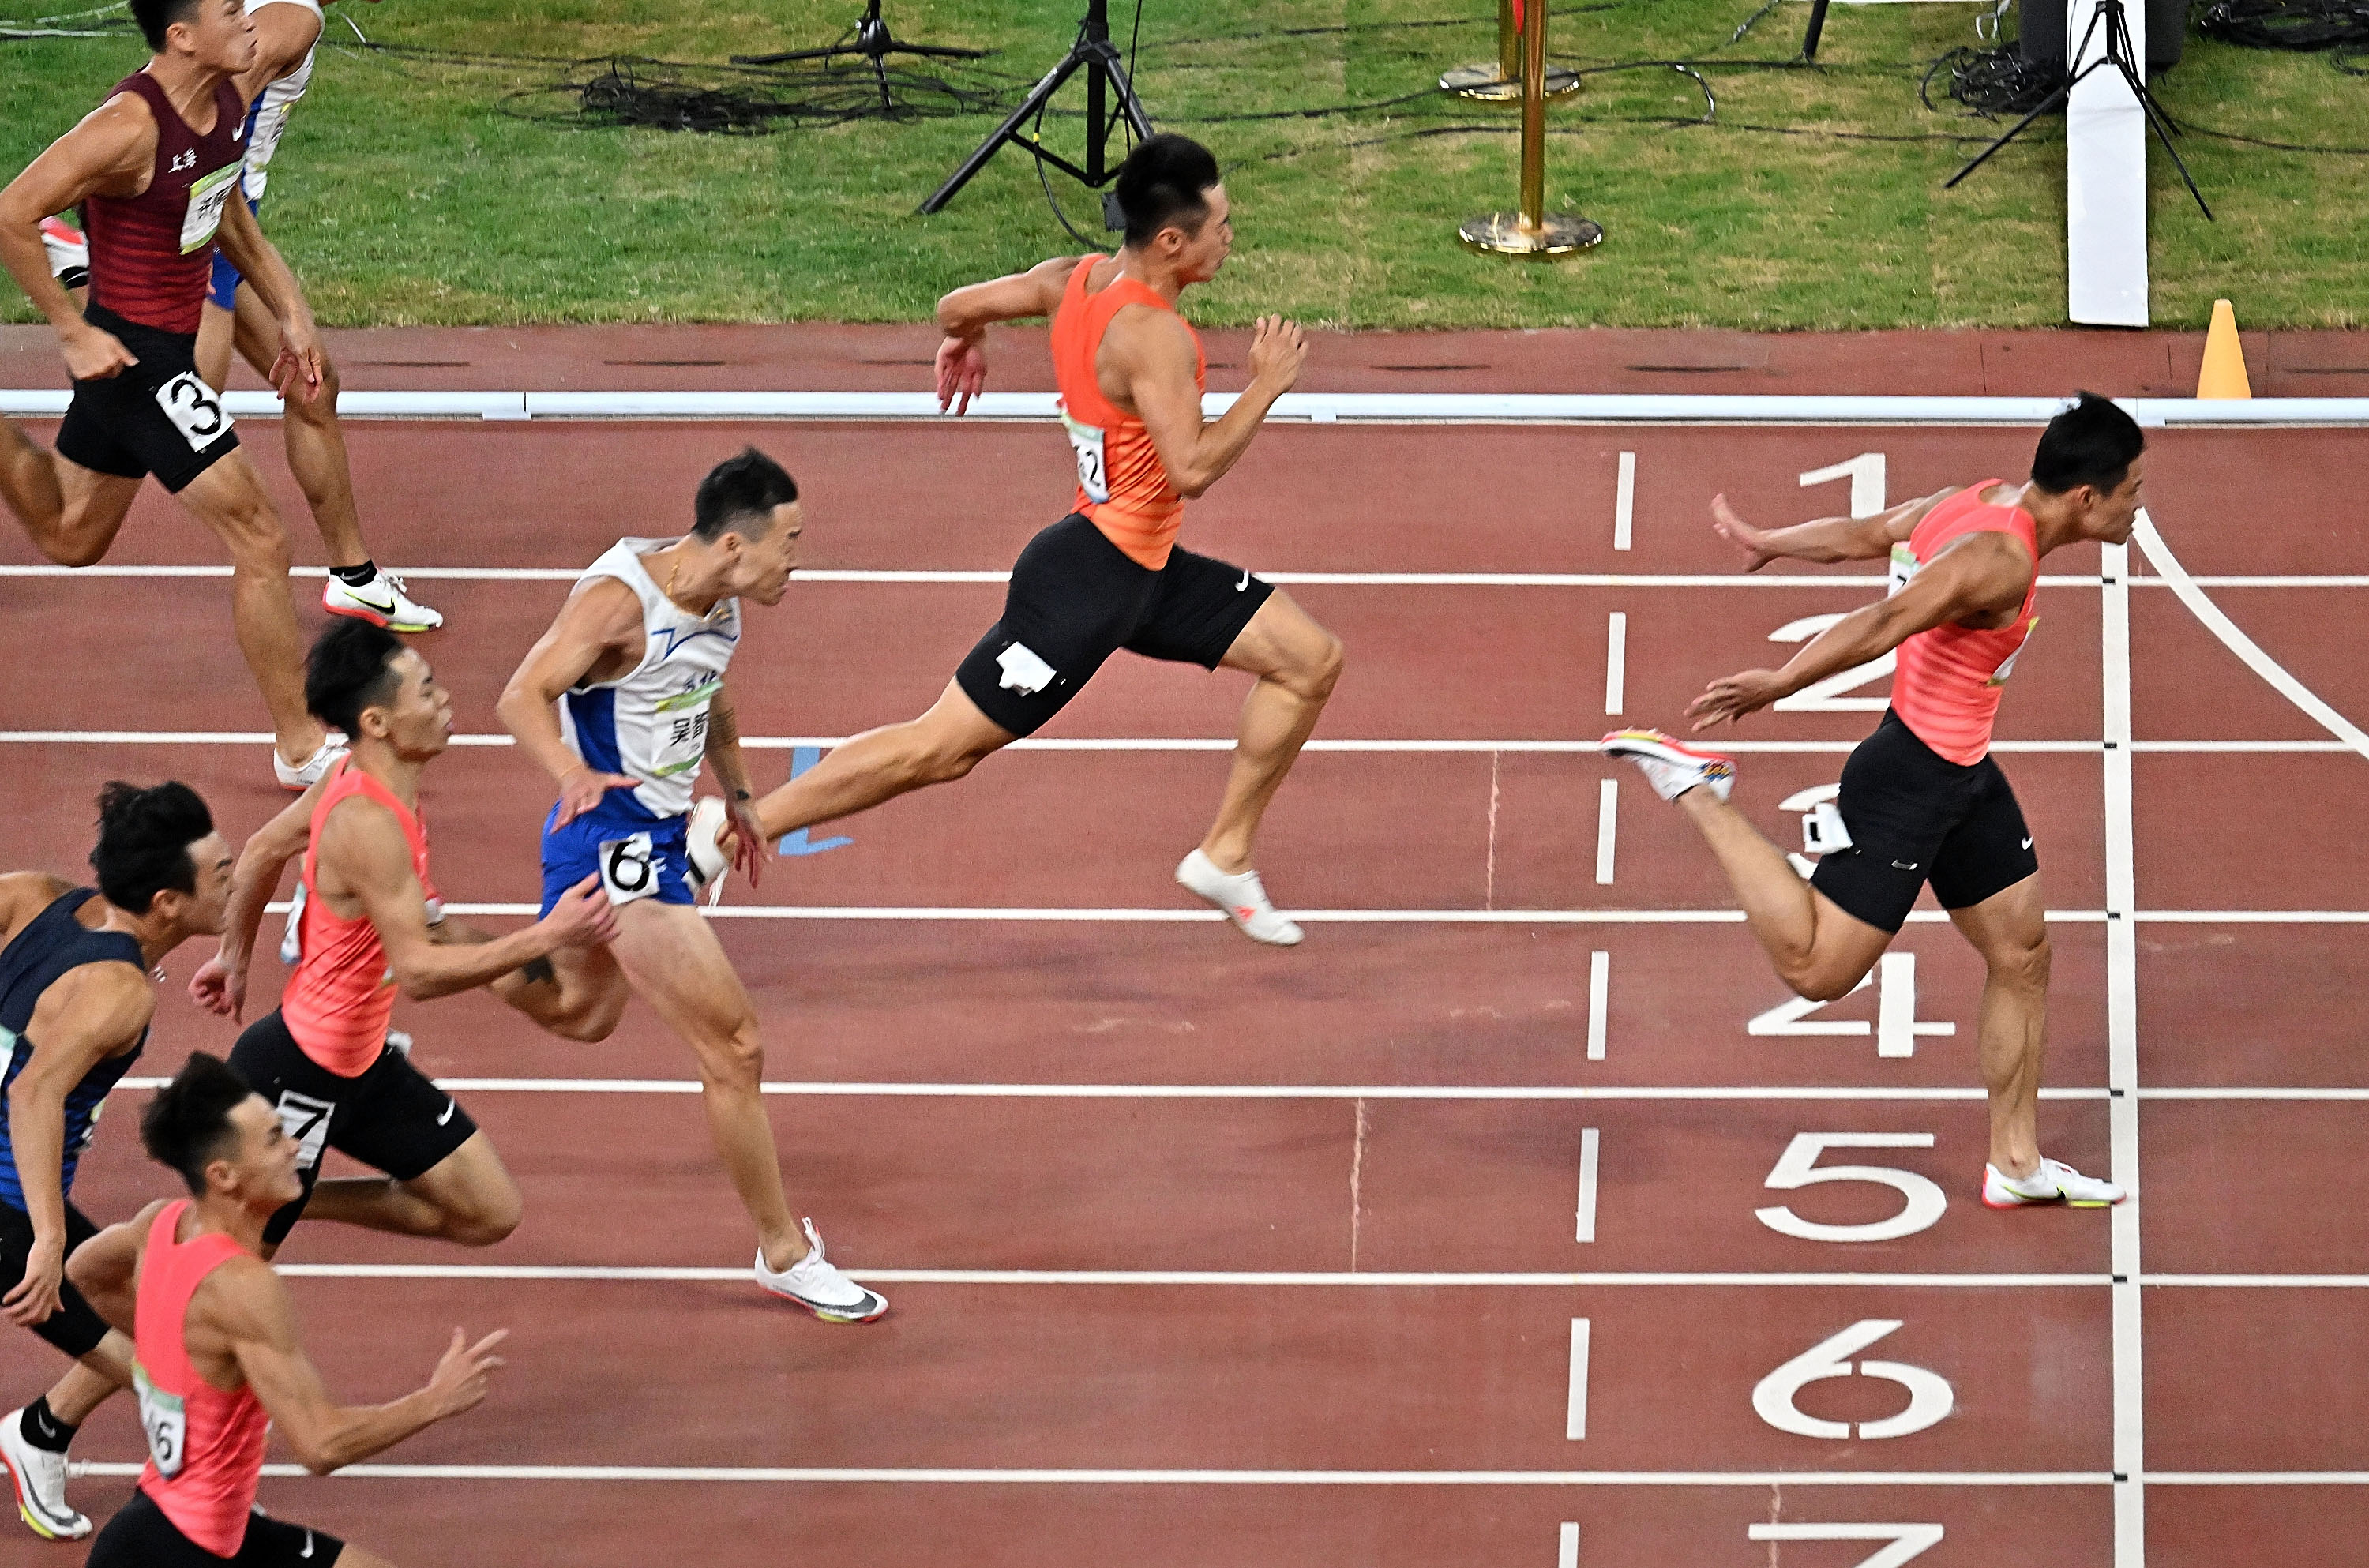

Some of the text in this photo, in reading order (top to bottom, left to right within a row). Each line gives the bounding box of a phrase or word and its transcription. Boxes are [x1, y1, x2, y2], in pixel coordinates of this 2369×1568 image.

[171, 378, 222, 436] 3
[1800, 452, 1886, 519] 1
[1768, 613, 1896, 712] 2
[609, 839, 651, 892] 6
[1748, 951, 1956, 1059] 4
[283, 1098, 329, 1142] 7
[1755, 1131, 1947, 1243] 5
[1751, 1319, 1954, 1440] 6
